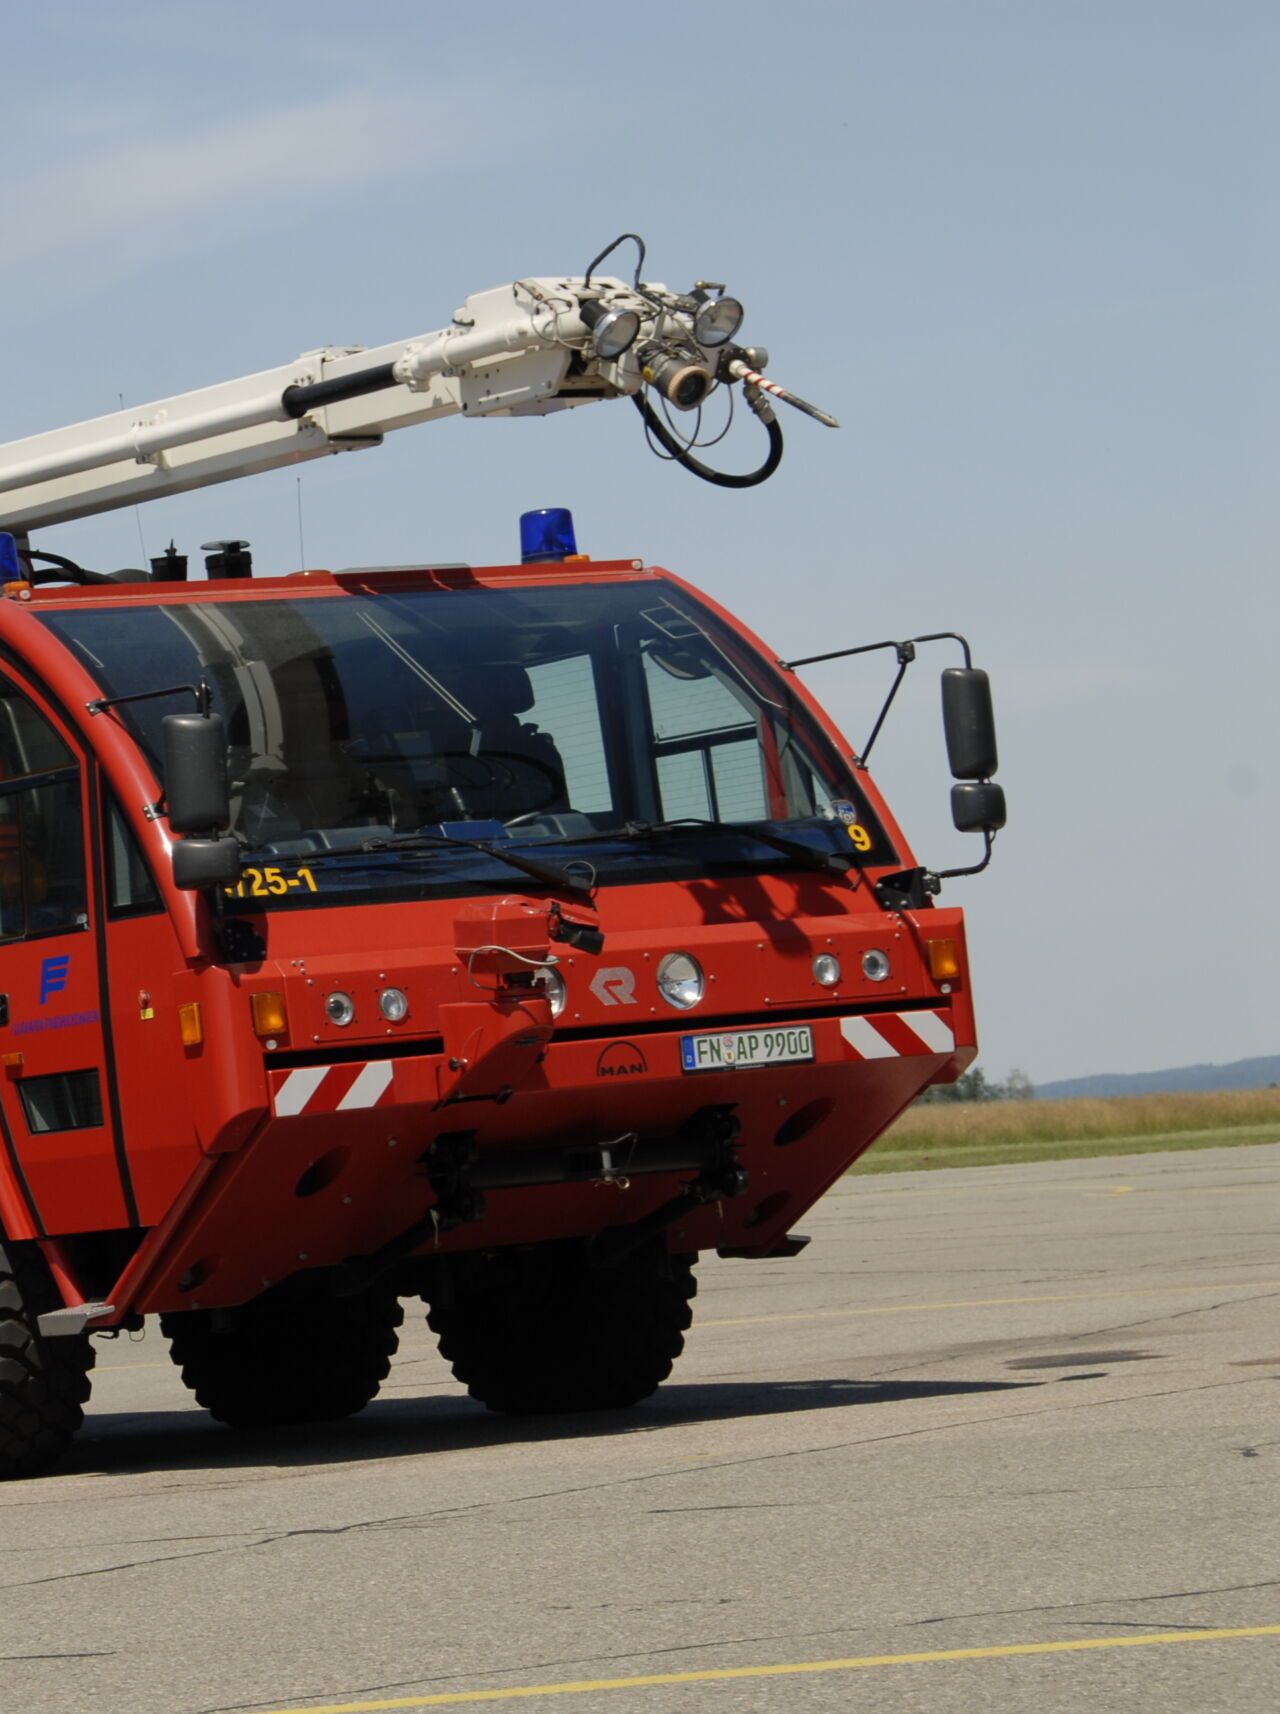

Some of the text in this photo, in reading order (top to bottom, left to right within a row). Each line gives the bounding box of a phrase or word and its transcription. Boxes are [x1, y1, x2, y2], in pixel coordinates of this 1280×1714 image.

[847, 824, 871, 851] 9
[696, 1038, 723, 1063] FN
[737, 1035, 759, 1060] AP
[763, 1030, 810, 1058] 9900
[599, 1064, 643, 1076] MAN
